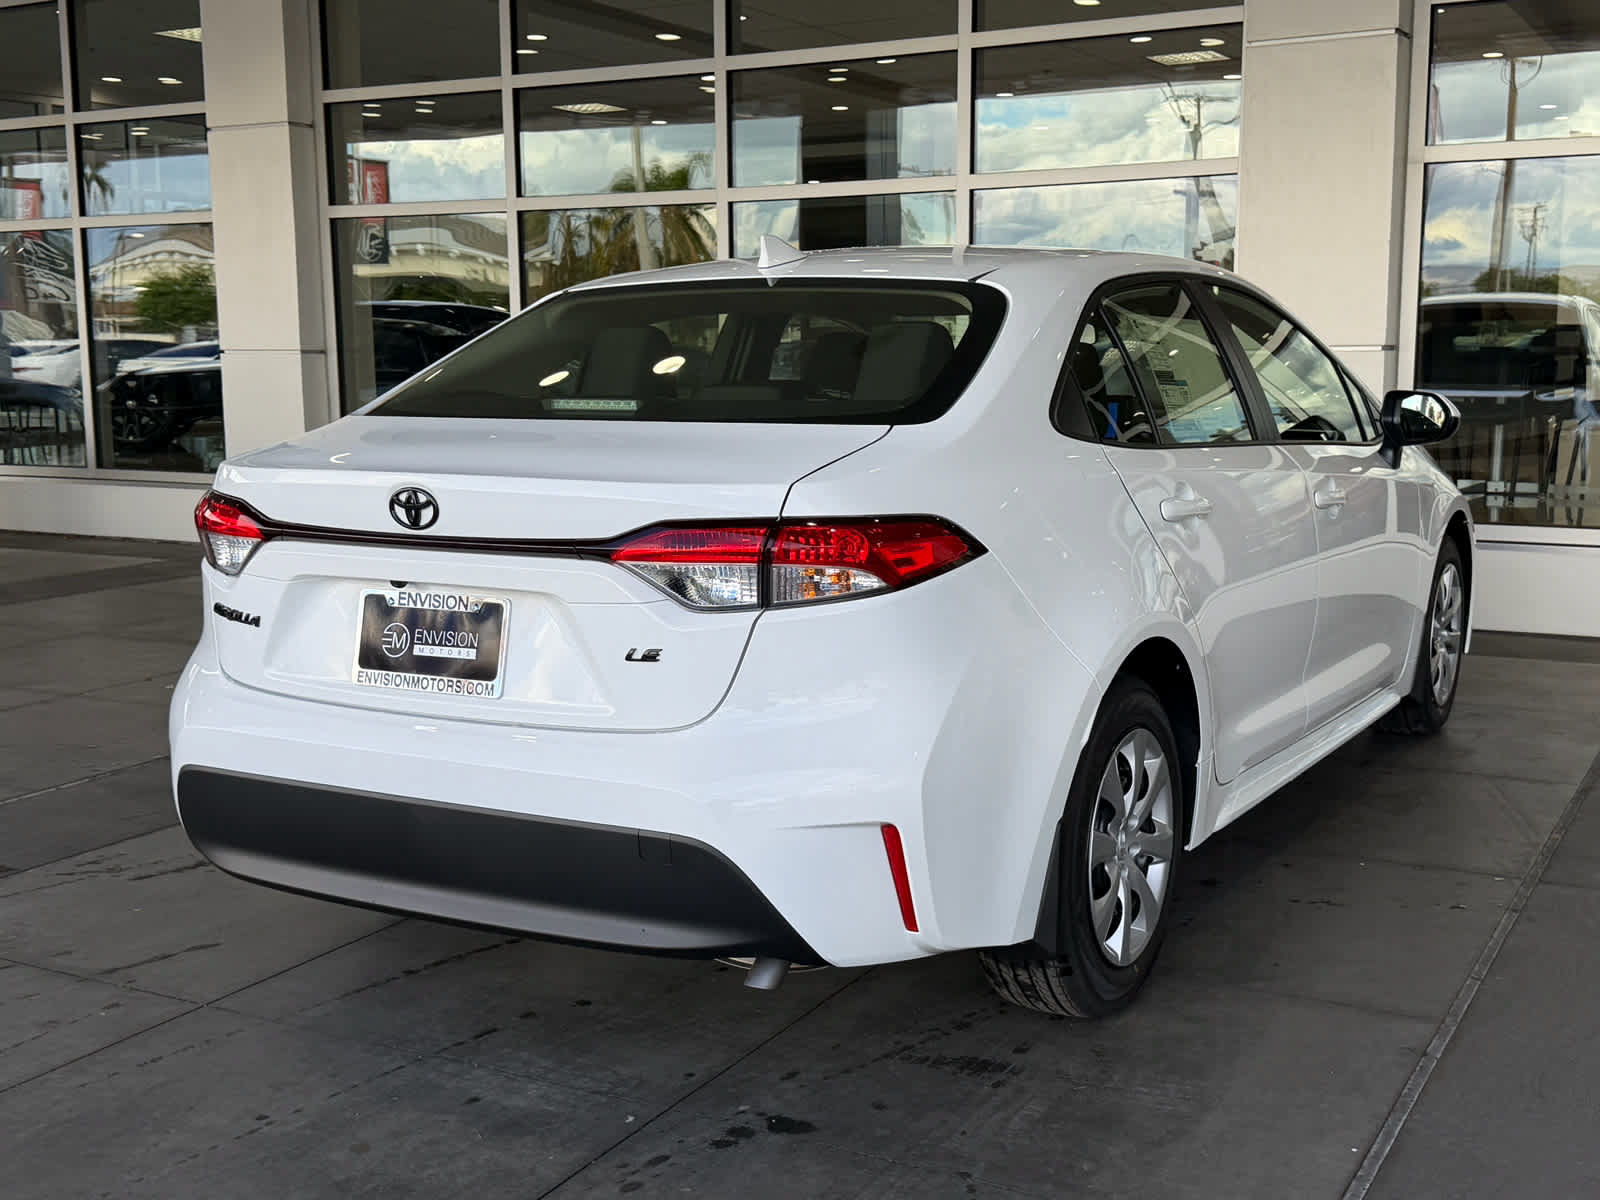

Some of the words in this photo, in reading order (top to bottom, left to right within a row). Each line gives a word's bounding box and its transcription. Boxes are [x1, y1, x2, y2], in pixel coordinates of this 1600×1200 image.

[397, 591, 470, 611] ENVISION
[414, 628, 479, 648] ENVISION
[418, 646, 472, 658] MOTORS
[625, 648, 663, 662] LE
[357, 670, 495, 697] ENVISIONMOTORS.COM
